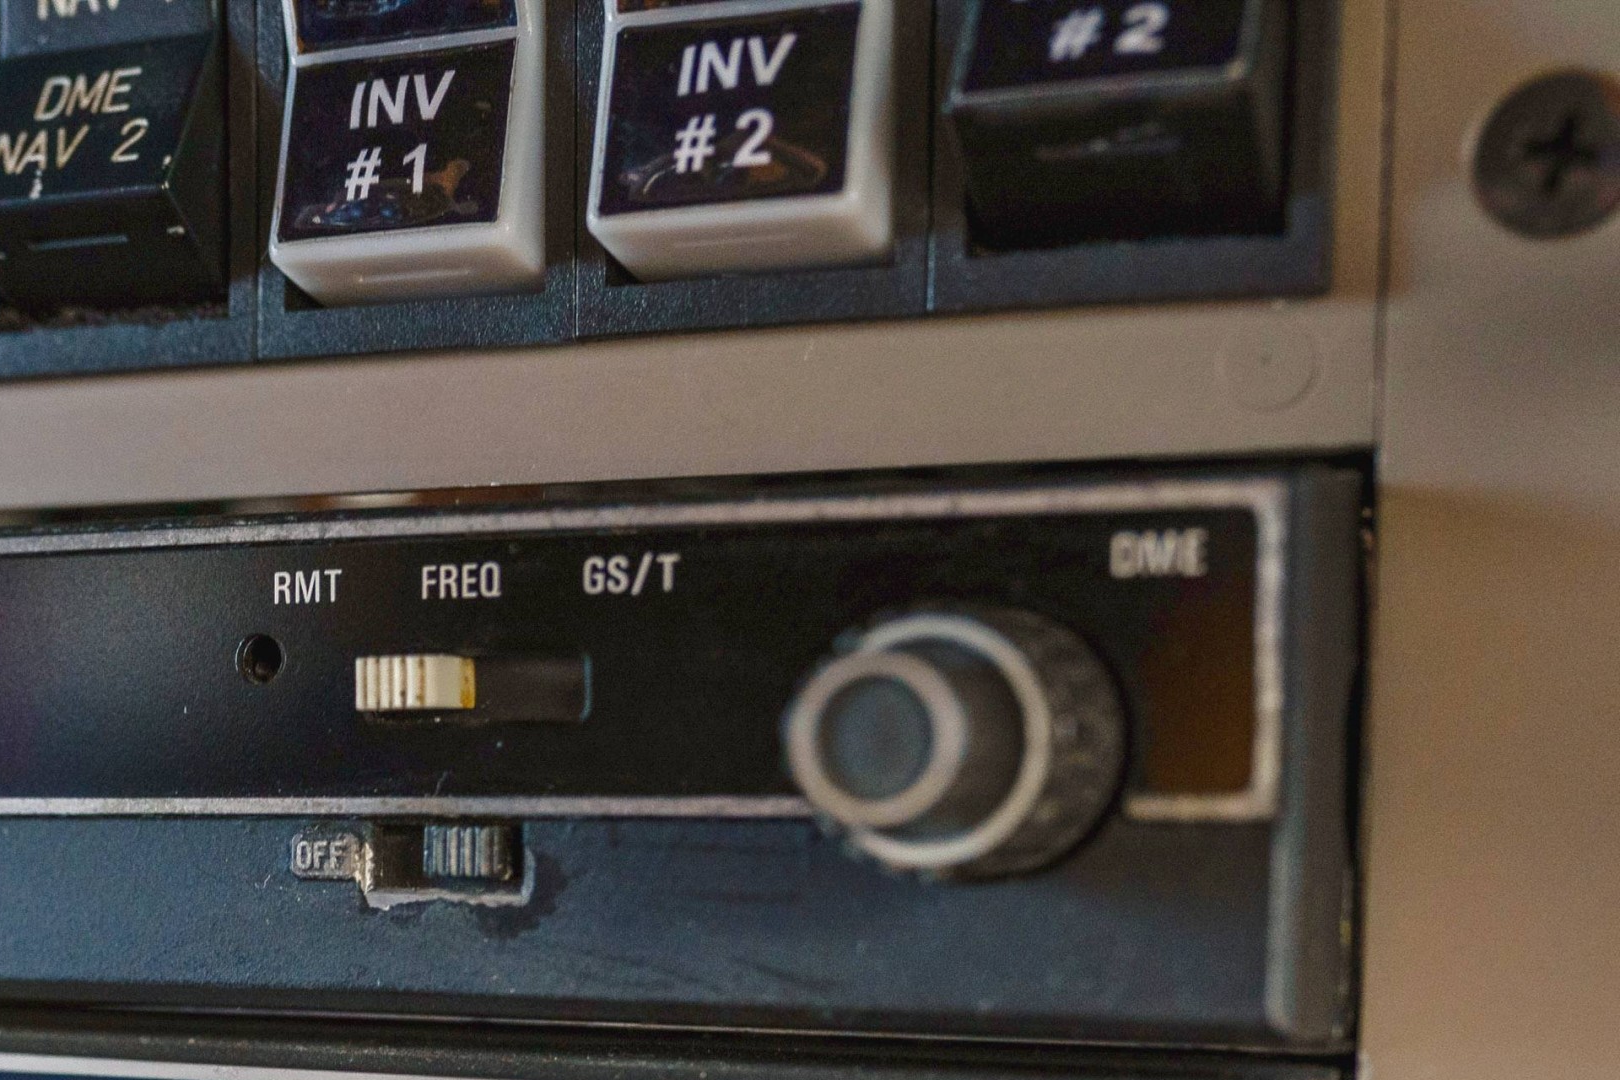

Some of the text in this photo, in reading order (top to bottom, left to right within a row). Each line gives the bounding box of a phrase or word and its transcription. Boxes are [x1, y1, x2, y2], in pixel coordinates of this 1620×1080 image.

[677, 32, 798, 97] INV
[33, 66, 143, 121] DME
[349, 69, 456, 129] INV
[110, 117, 150, 164] 2
[583, 552, 681, 597] GS/T
[1109, 527, 1210, 579] DME
[273, 568, 343, 604] RMT
[421, 560, 502, 600] FREQ
[295, 839, 348, 872] OFF
